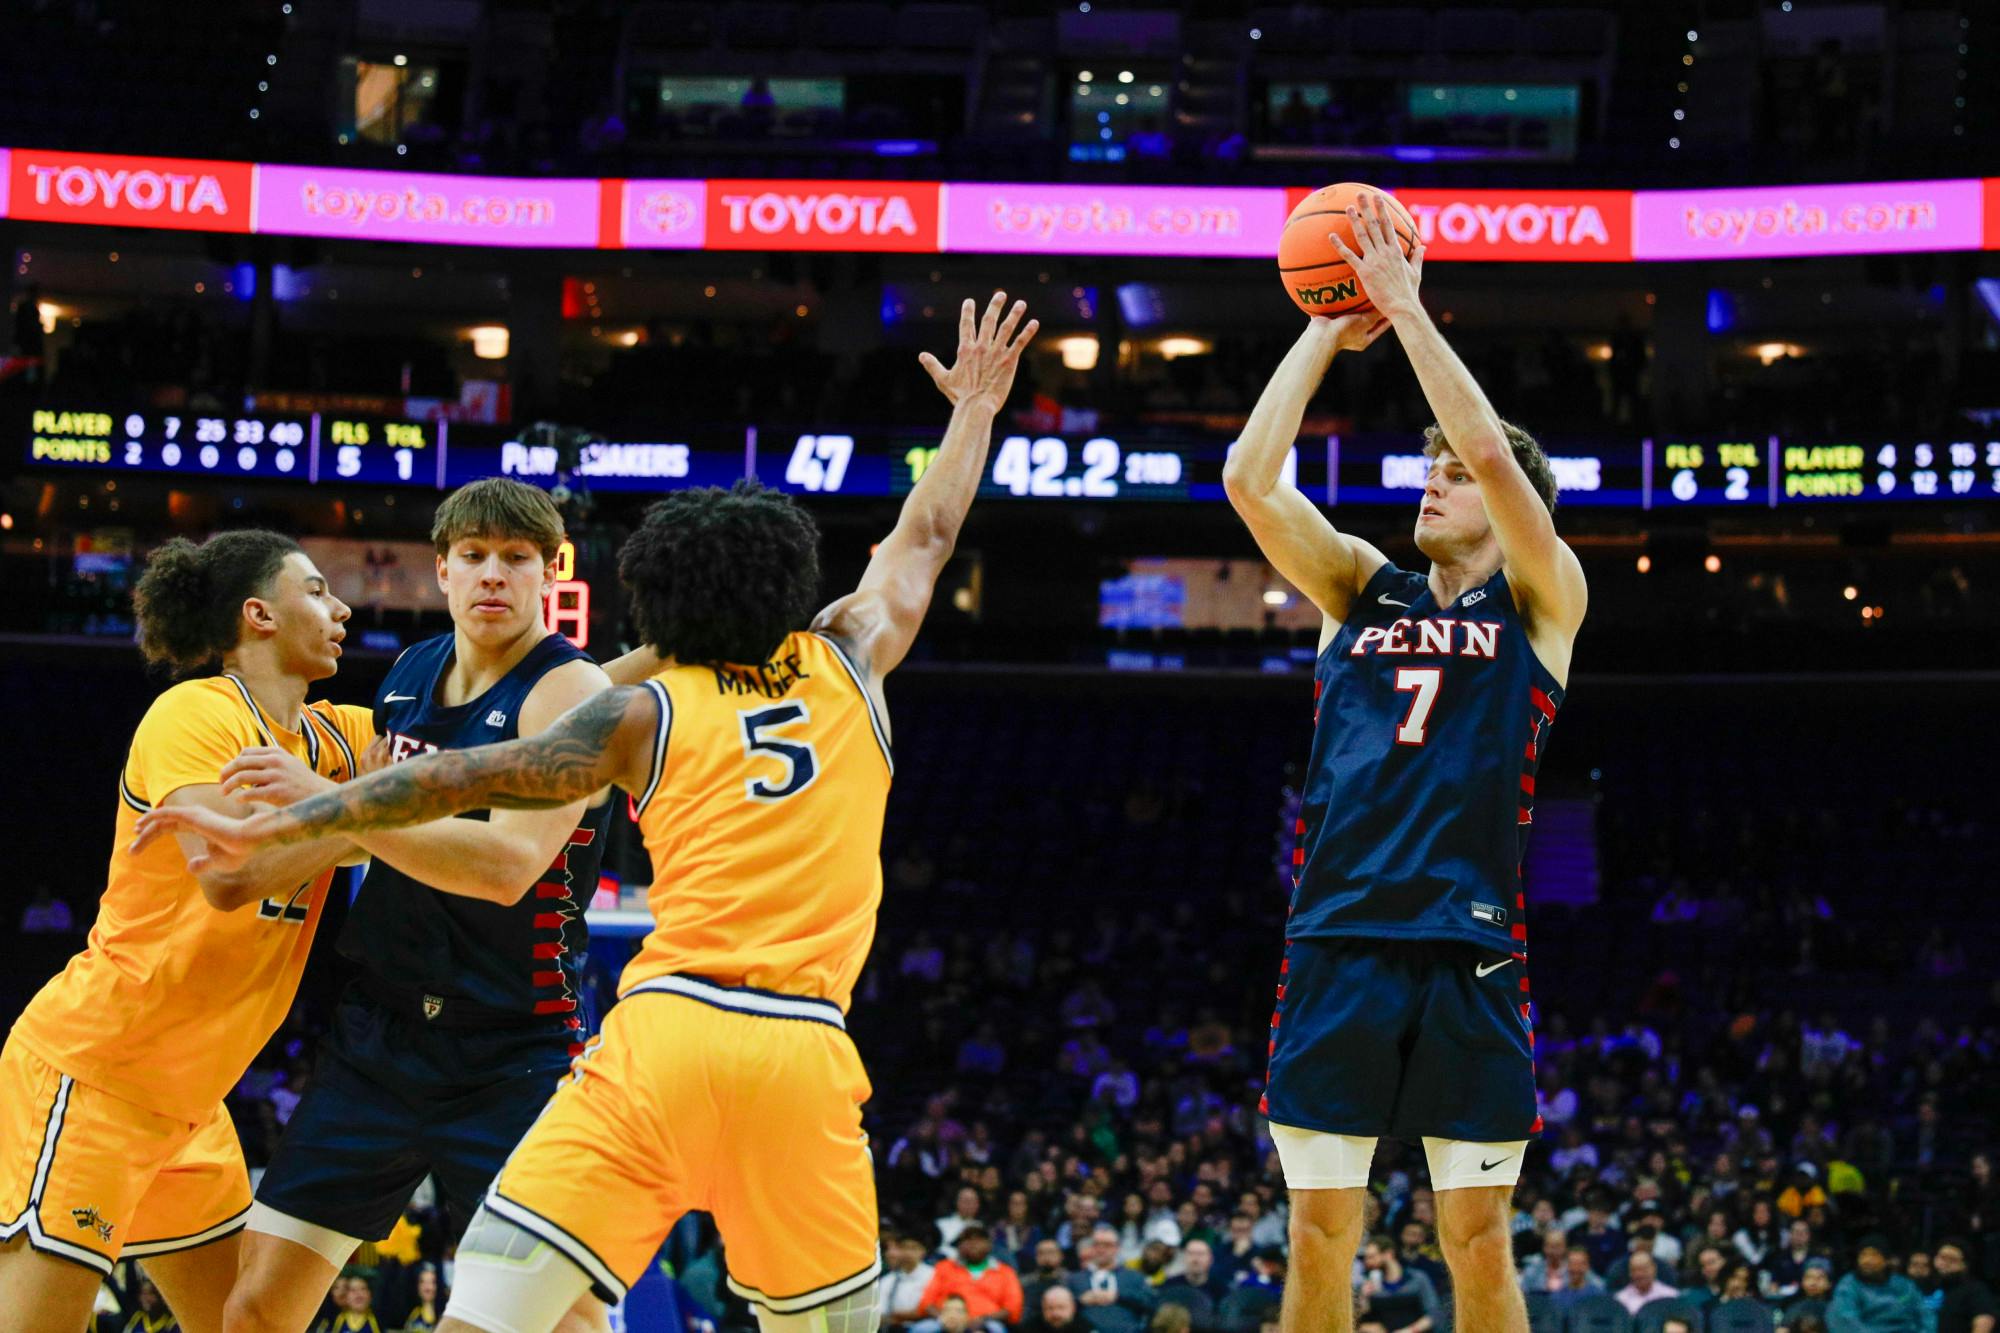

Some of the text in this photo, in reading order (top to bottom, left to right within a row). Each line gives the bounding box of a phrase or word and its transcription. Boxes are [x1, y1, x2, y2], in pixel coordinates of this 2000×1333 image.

[27, 164, 228, 215] TOYOTA
[303, 182, 555, 226] toyota.com
[721, 192, 917, 235] TOYOTA
[992, 199, 1240, 239] toyota.com
[1409, 202, 1609, 245] TOYOTA
[1684, 200, 1936, 245] toyota.com
[1296, 279, 1357, 304] NCAA
[33, 410, 113, 436] PLAYER
[125, 414, 145, 438] 0
[164, 416, 181, 439] 7
[234, 420, 264, 444] 33
[269, 422, 303, 446] 40
[331, 421, 426, 448] FLS TOL
[32, 437, 295, 472] POINTS 2 0 0 0 0
[336, 445, 413, 480] 5 1
[785, 435, 854, 492] 47
[993, 436, 1120, 496] 42.2
[1665, 443, 1759, 469] FLS TOL
[1784, 446, 1864, 470] PLAYER
[1877, 444, 1896, 468] 4
[1986, 442, 2000, 466] 2
[1671, 467, 1749, 500] 6 2
[1785, 473, 1864, 497] POINTS
[1351, 618, 1502, 659] PENN
[1394, 667, 1443, 745] 7
[736, 698, 820, 805] 5
